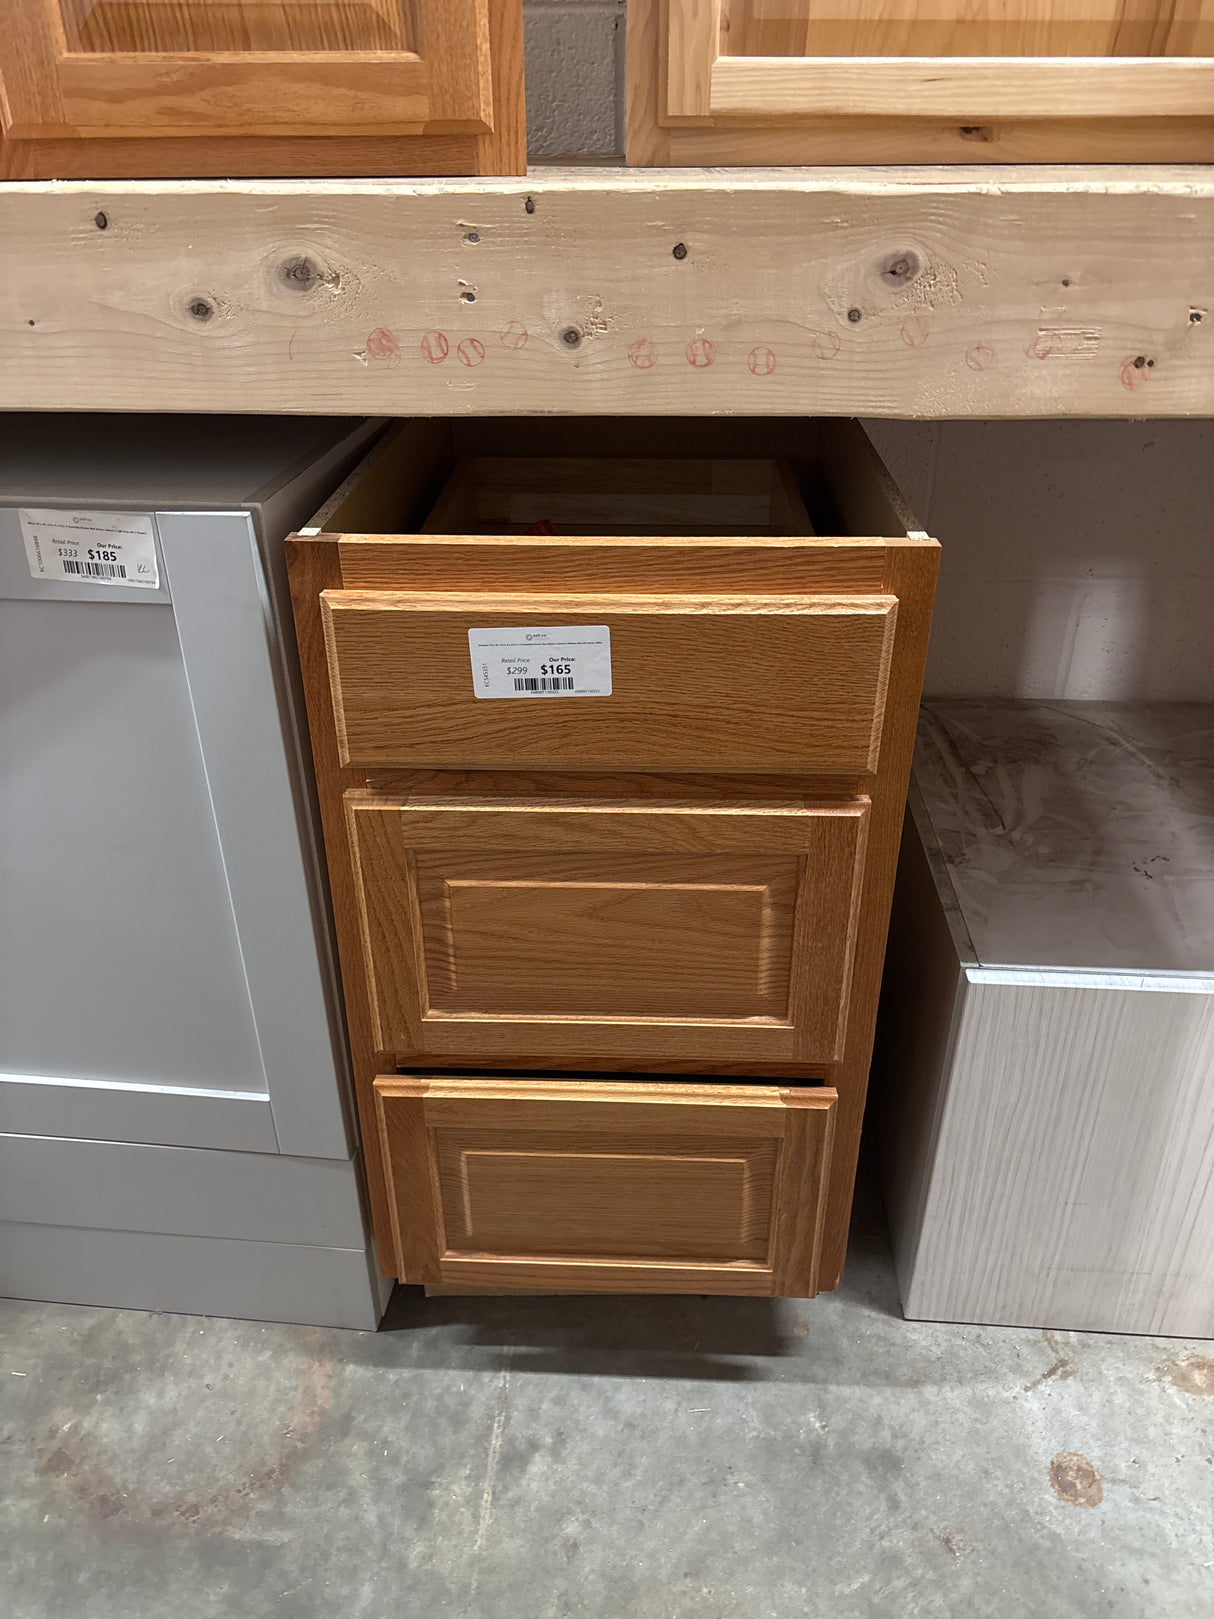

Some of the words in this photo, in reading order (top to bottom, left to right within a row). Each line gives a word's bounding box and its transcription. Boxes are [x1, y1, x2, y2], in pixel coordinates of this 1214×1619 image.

[58, 547, 78, 558] $333
[87, 548, 117, 562] $185
[506, 666, 528, 675] $299
[540, 664, 571, 676] $165
